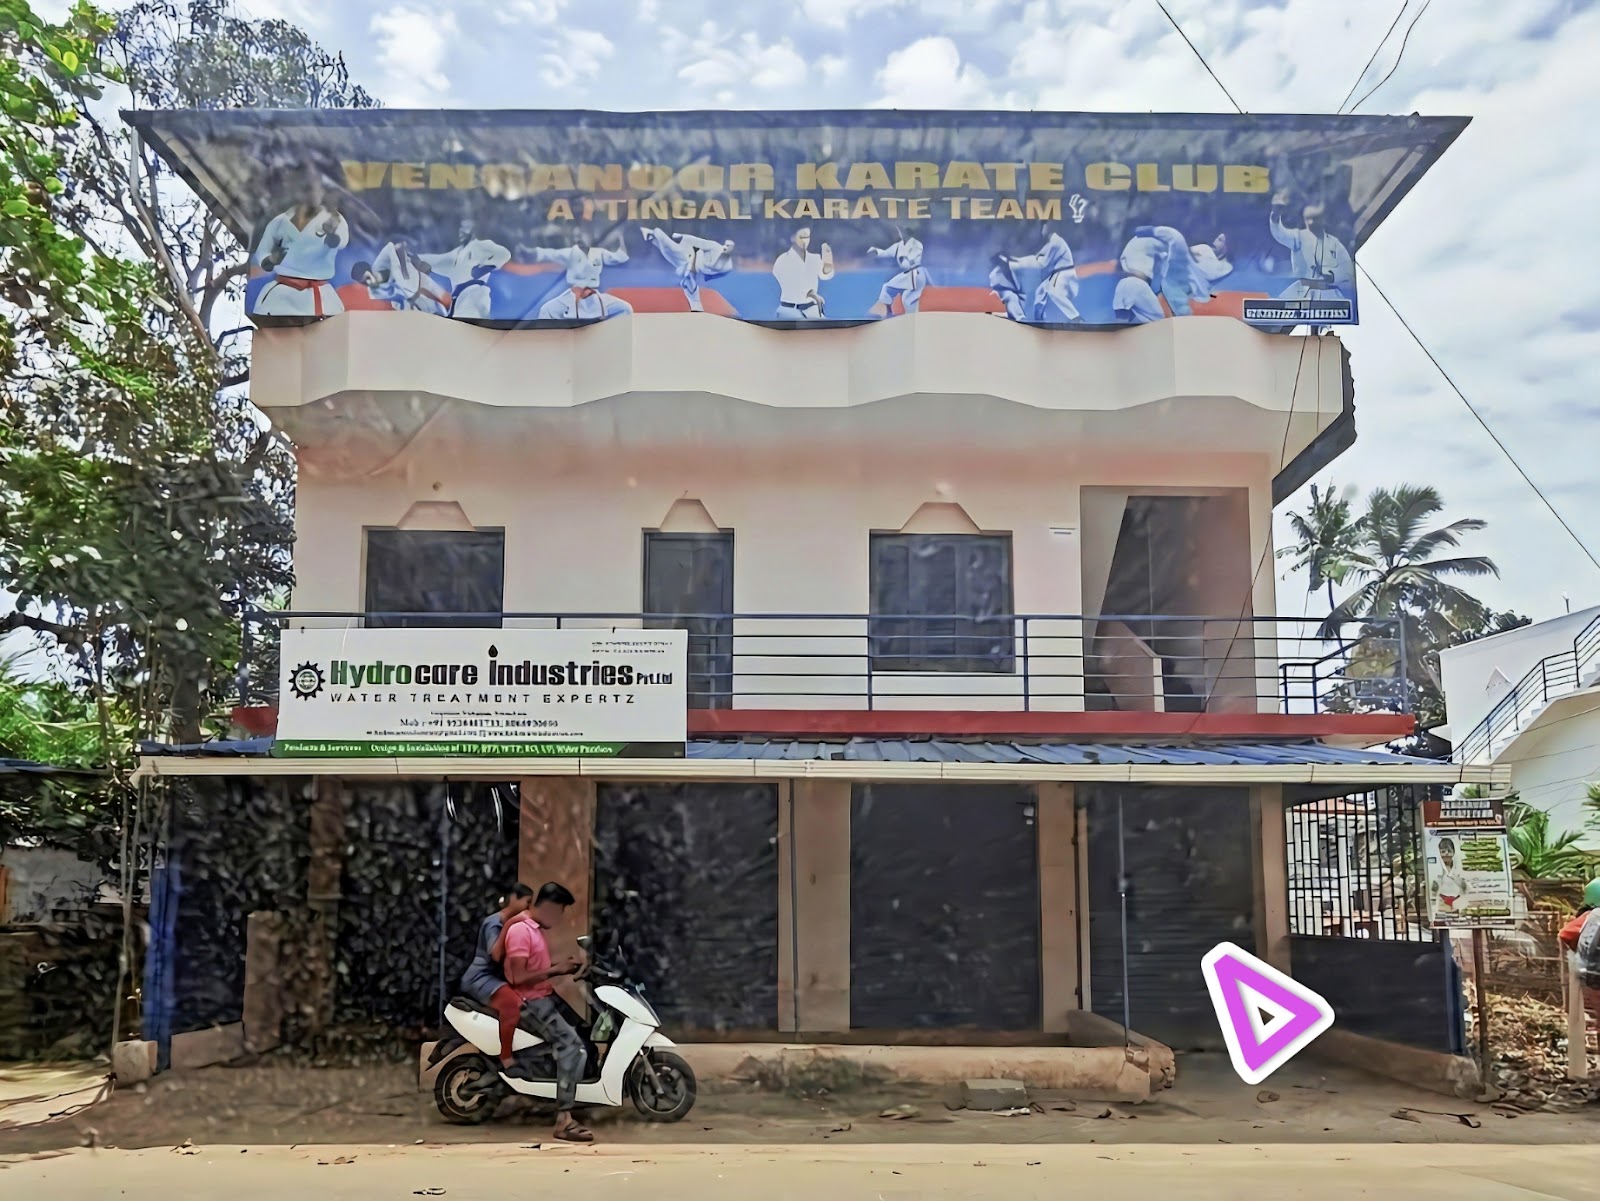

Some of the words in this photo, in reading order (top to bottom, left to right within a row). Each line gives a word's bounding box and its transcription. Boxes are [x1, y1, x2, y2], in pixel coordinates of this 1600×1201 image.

[796, 161, 1064, 191] KARATE
[1085, 162, 1270, 193] CLUB
[765, 196, 931, 220] KARATE
[943, 197, 1062, 221] TEAM
[331, 660, 477, 688] Hydrocare
[331, 693, 397, 703] WATER
[543, 694, 635, 703] EXPERTZ
